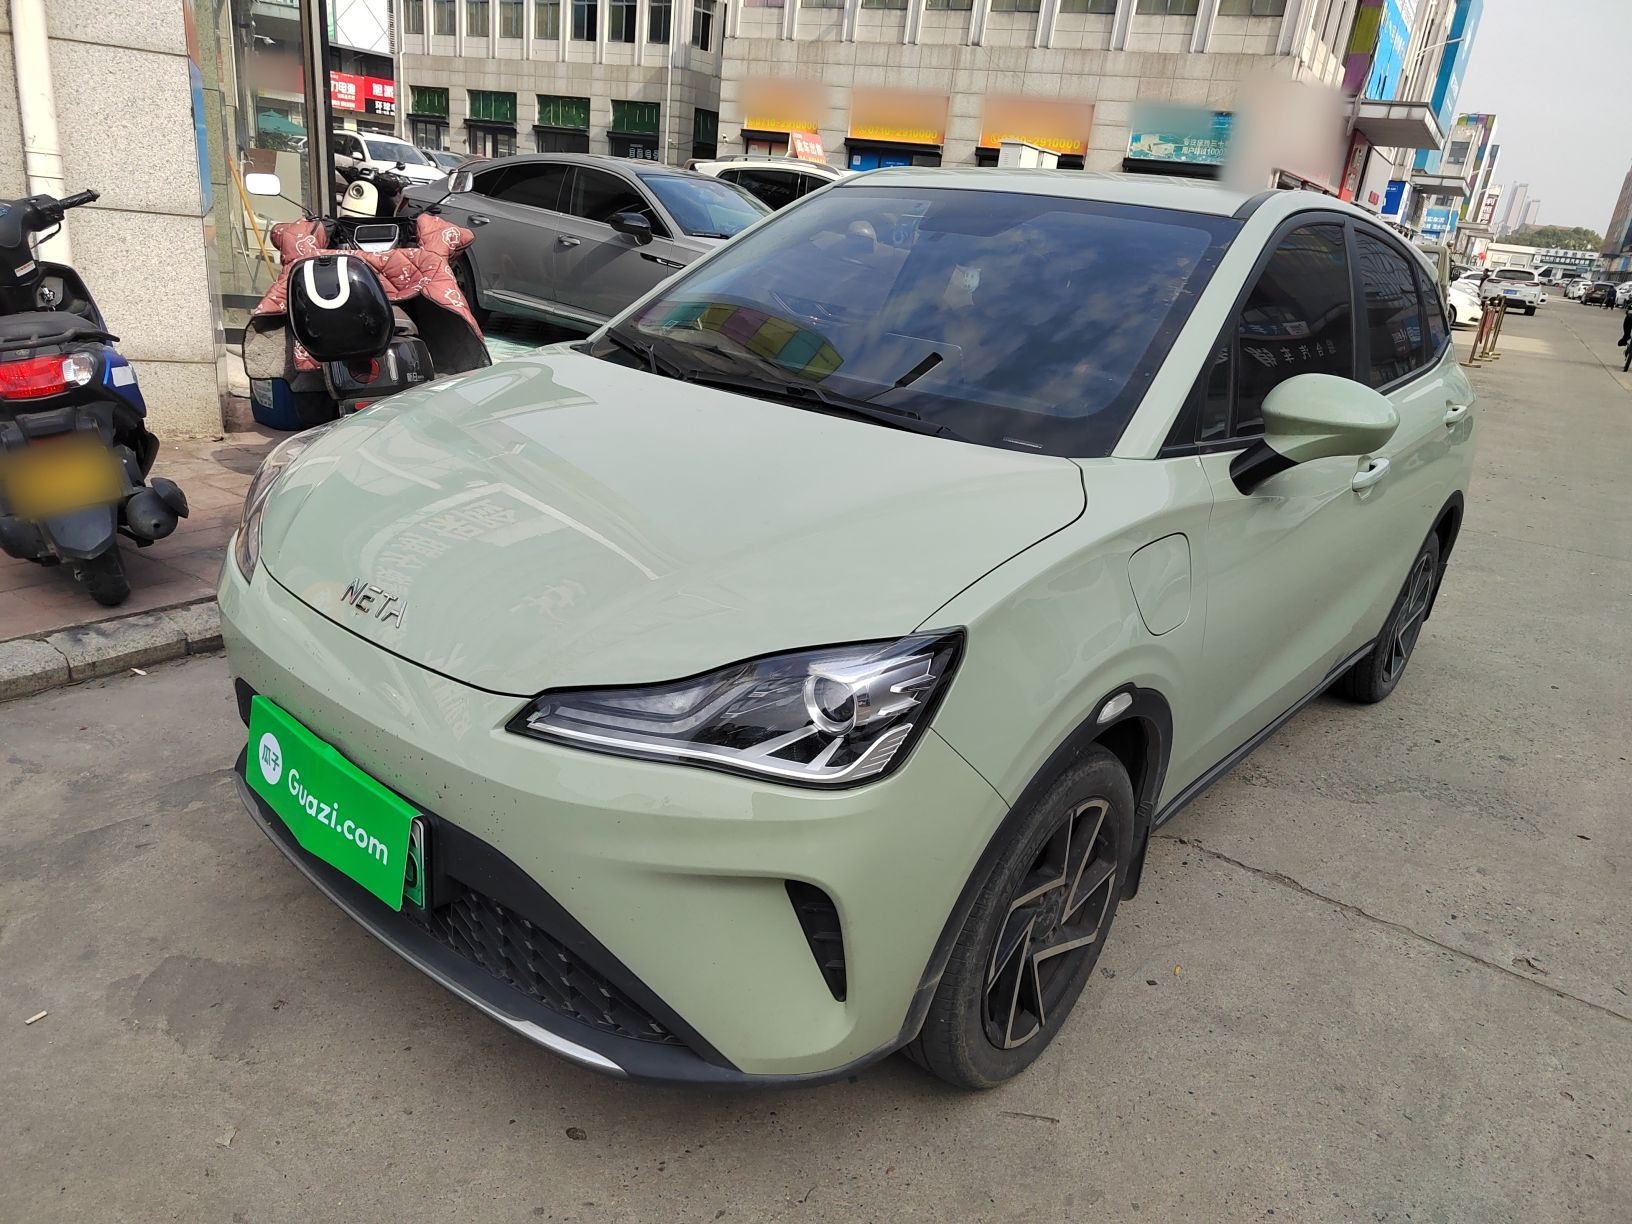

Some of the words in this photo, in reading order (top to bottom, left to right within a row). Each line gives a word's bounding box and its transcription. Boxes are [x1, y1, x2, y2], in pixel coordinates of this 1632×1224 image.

[868, 125, 938, 139] 0710-2910000
[340, 576, 408, 629] NETA
[262, 743, 280, 772] 瓜子
[288, 768, 388, 866] Guazi.com
